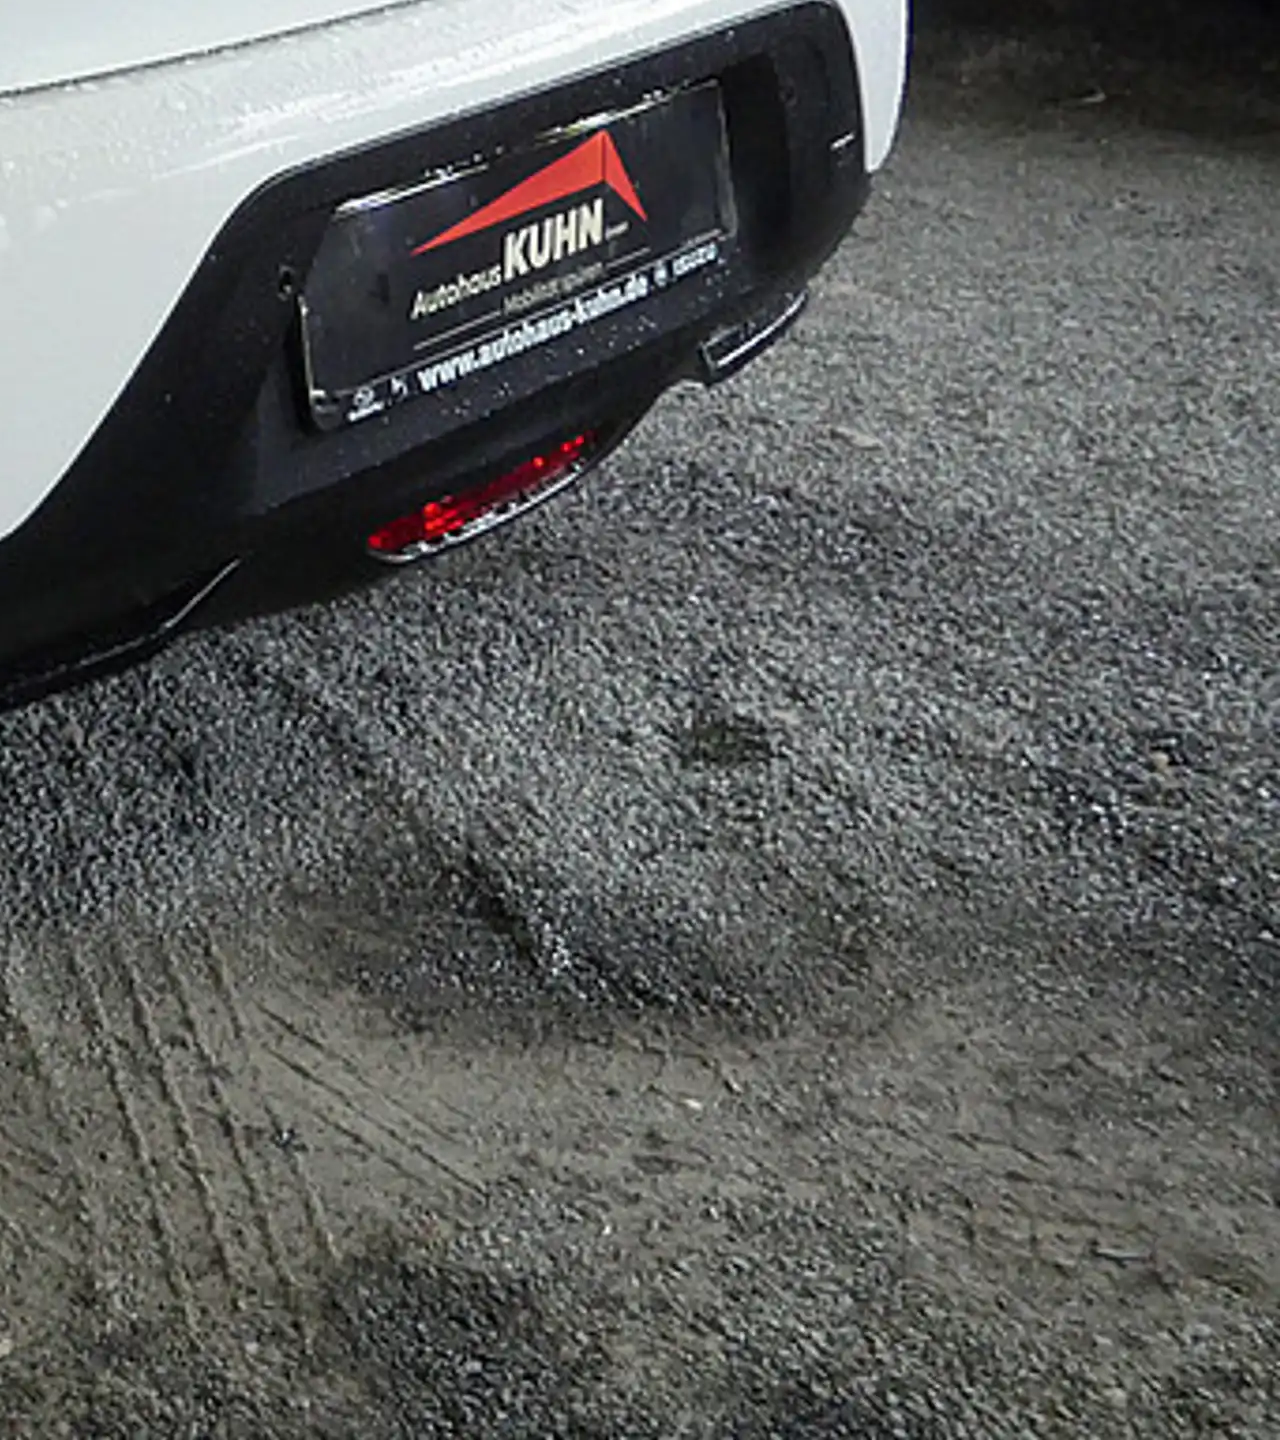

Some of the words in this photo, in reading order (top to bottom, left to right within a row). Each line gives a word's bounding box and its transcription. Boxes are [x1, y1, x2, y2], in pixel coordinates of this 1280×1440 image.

[410, 264, 502, 320] Autohaus
[503, 197, 604, 283] KUHN
[417, 271, 649, 392] www.autohaus-kuhn.de
